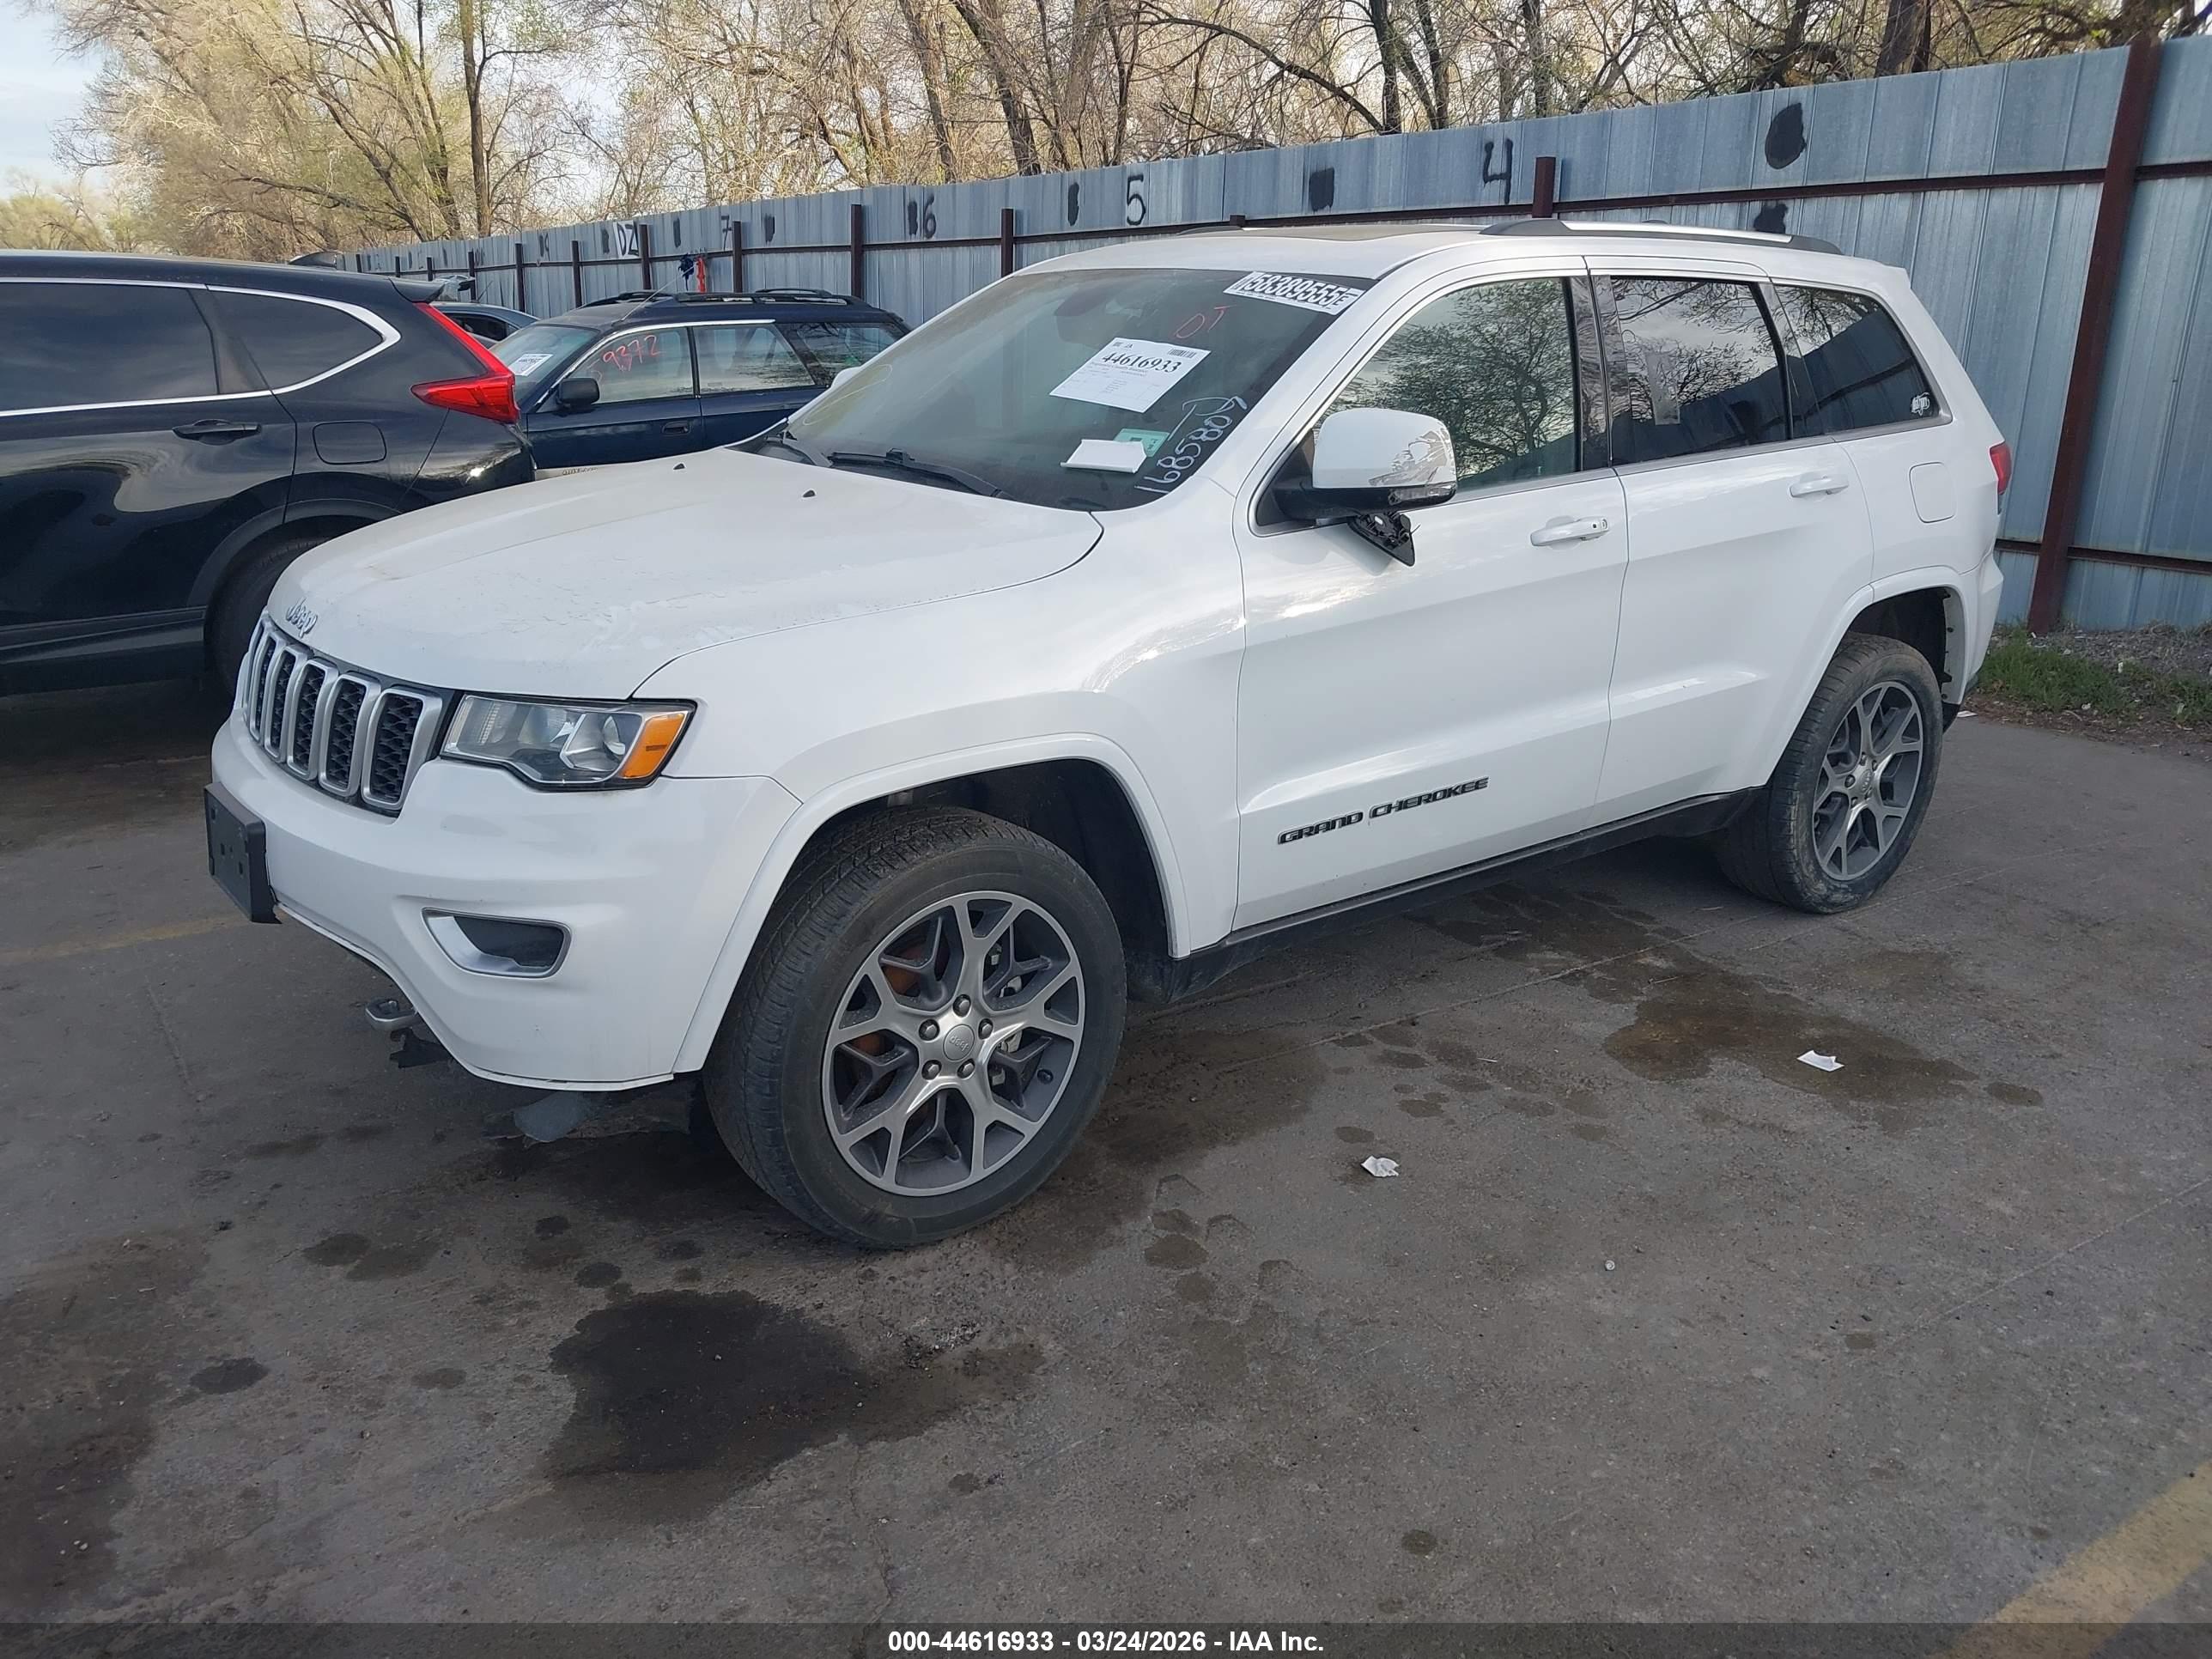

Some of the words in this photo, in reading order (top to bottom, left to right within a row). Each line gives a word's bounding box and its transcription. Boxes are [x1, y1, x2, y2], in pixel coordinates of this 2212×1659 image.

[1483, 138, 1513, 204] 4
[1126, 173, 1146, 226] 5
[720, 214, 733, 251] 7
[1243, 272, 1351, 307] 58389555
[1102, 352, 1182, 373] 44616933
[285, 597, 318, 638] Jeep
[1277, 811, 1364, 844] GRAND
[1369, 775, 1490, 818] CHEROKEE
